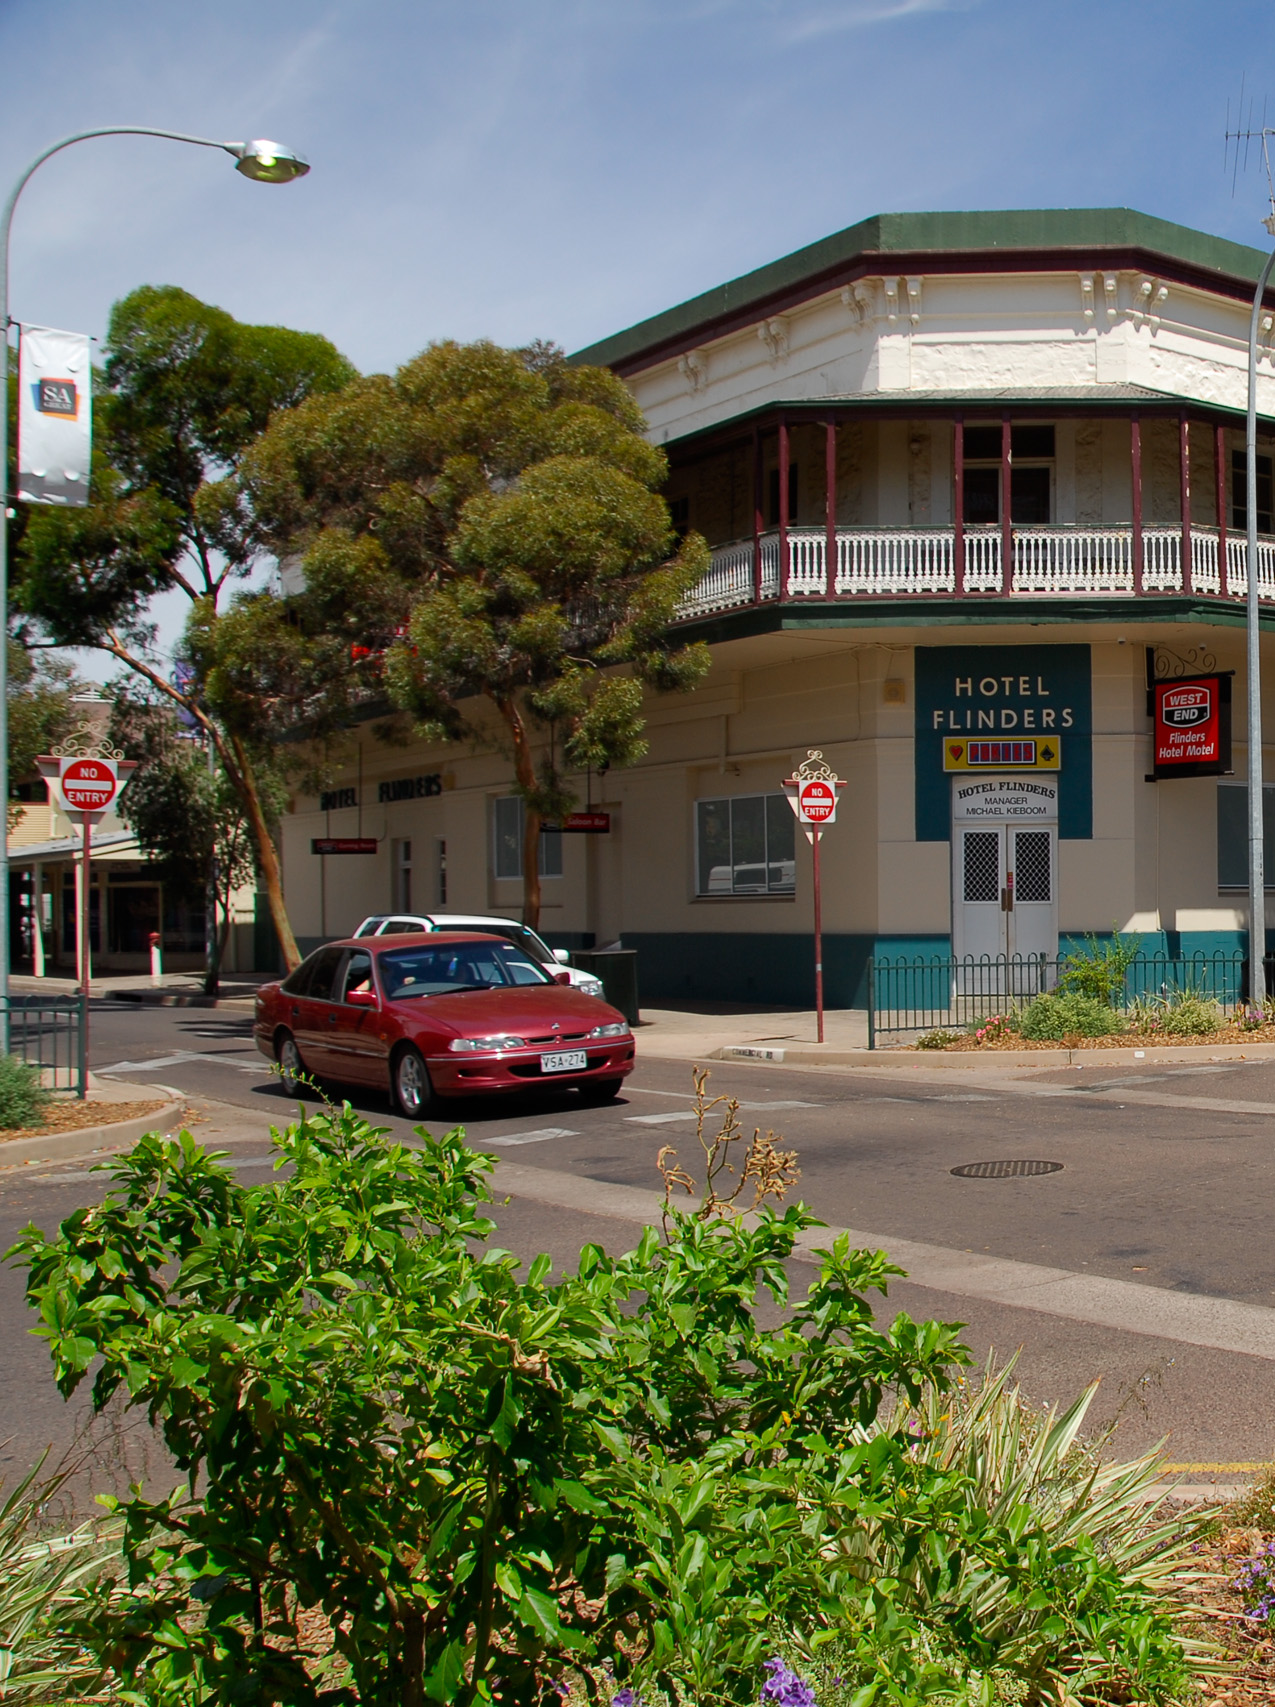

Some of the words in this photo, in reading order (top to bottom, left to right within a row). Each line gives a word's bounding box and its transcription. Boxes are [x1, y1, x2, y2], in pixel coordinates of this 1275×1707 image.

[43, 386, 72, 404] SA
[954, 676, 1049, 697] HOTEL
[1169, 693, 1203, 706] WEST
[933, 708, 1074, 729] FLINDERS
[1173, 709, 1198, 721] END
[1169, 731, 1206, 744] Flinders
[969, 743, 1033, 761] POKIES
[1159, 745, 1184, 759] Hotel
[1186, 743, 1215, 756] Motel
[80, 768, 98, 778] NO
[811, 788, 823, 797] NO
[957, 782, 996, 799] HOTEL
[999, 782, 1056, 799] FLINDERS
[67, 791, 108, 803] ENTRY
[984, 797, 1028, 805] MANAGER
[804, 807, 830, 817] ENTRY
[966, 807, 1004, 815] MICHAEL
[1006, 807, 1047, 815] KIEBOOM
[567, 817, 592, 825] Saloon
